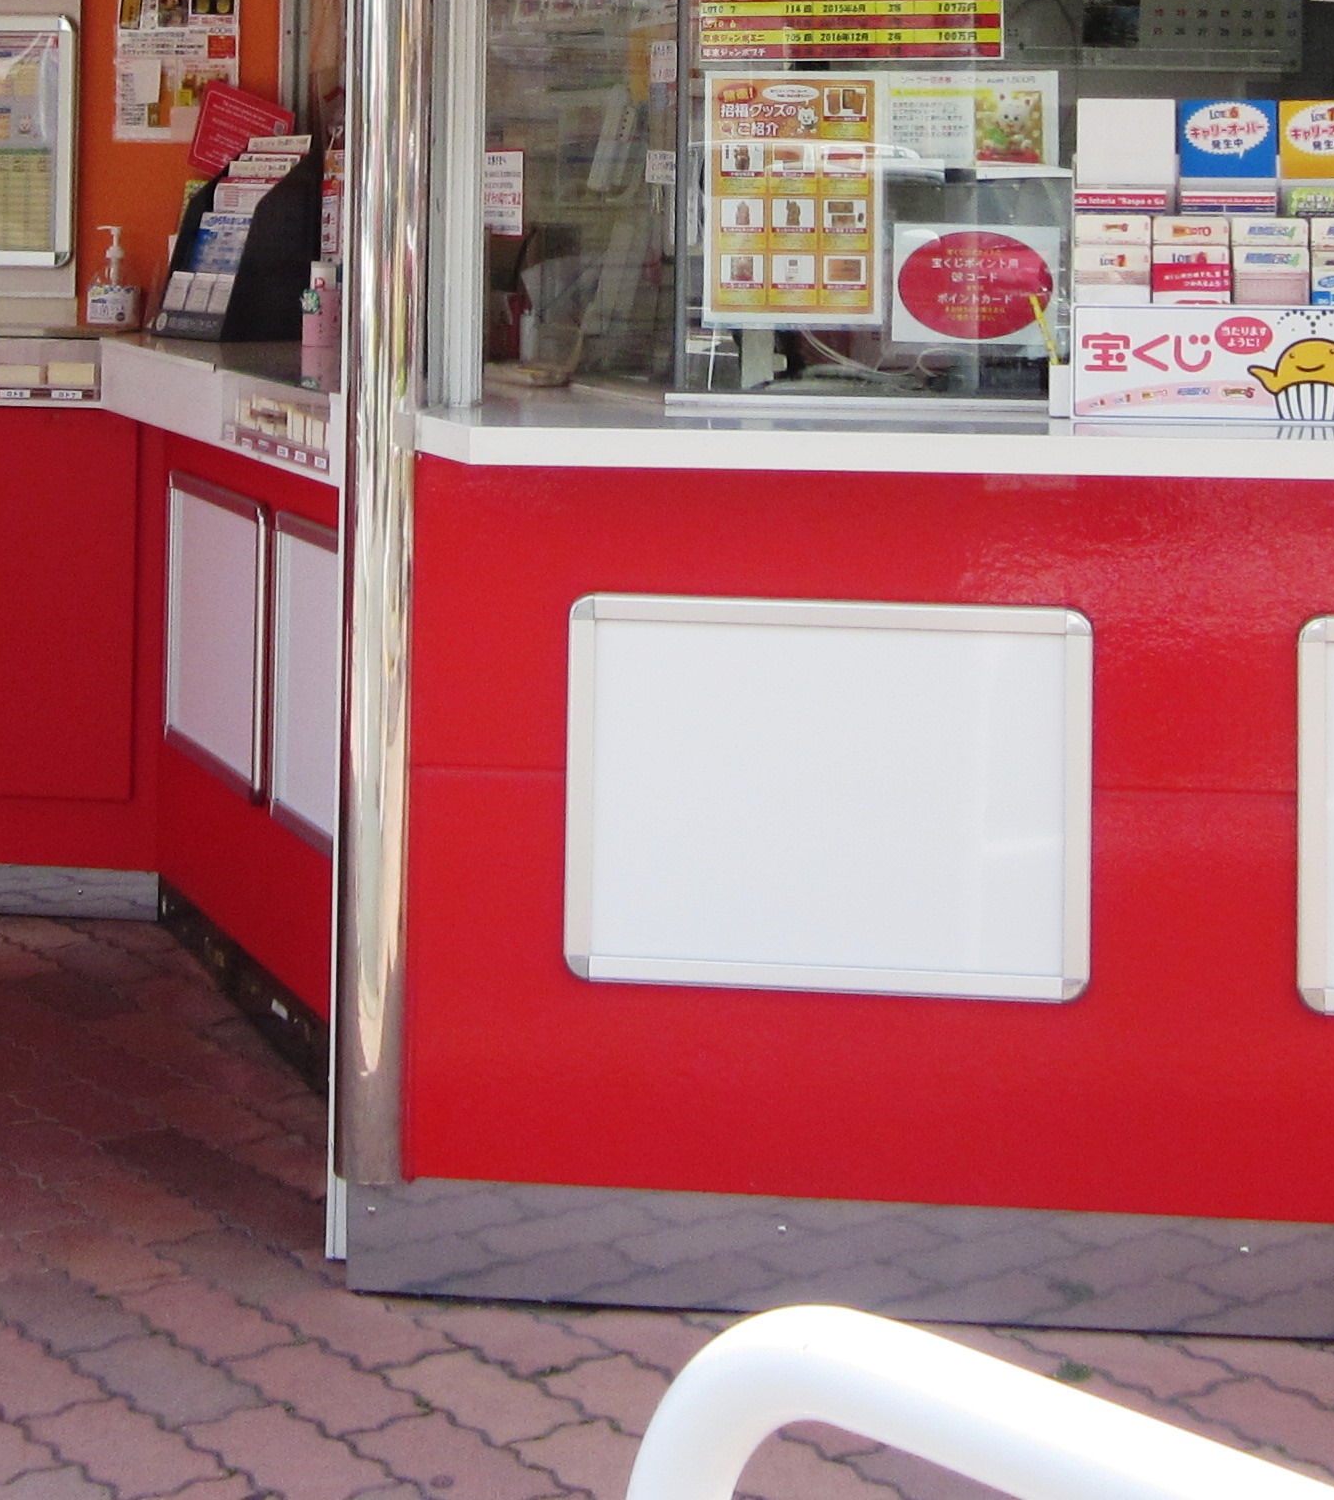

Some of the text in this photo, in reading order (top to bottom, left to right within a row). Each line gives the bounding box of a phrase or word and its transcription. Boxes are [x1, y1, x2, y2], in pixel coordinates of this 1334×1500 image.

[720, 102, 797, 119] 招福グッズの
[736, 120, 780, 137] ご紹介
[1190, 122, 1264, 139] キャリーオーバー
[1211, 138, 1244, 150] 発生中
[937, 293, 1013, 305] ポイントカード
[1219, 325, 1269, 338] 当たります
[1226, 336, 1261, 348] ように！
[1082, 331, 1213, 373] 宝くじ
